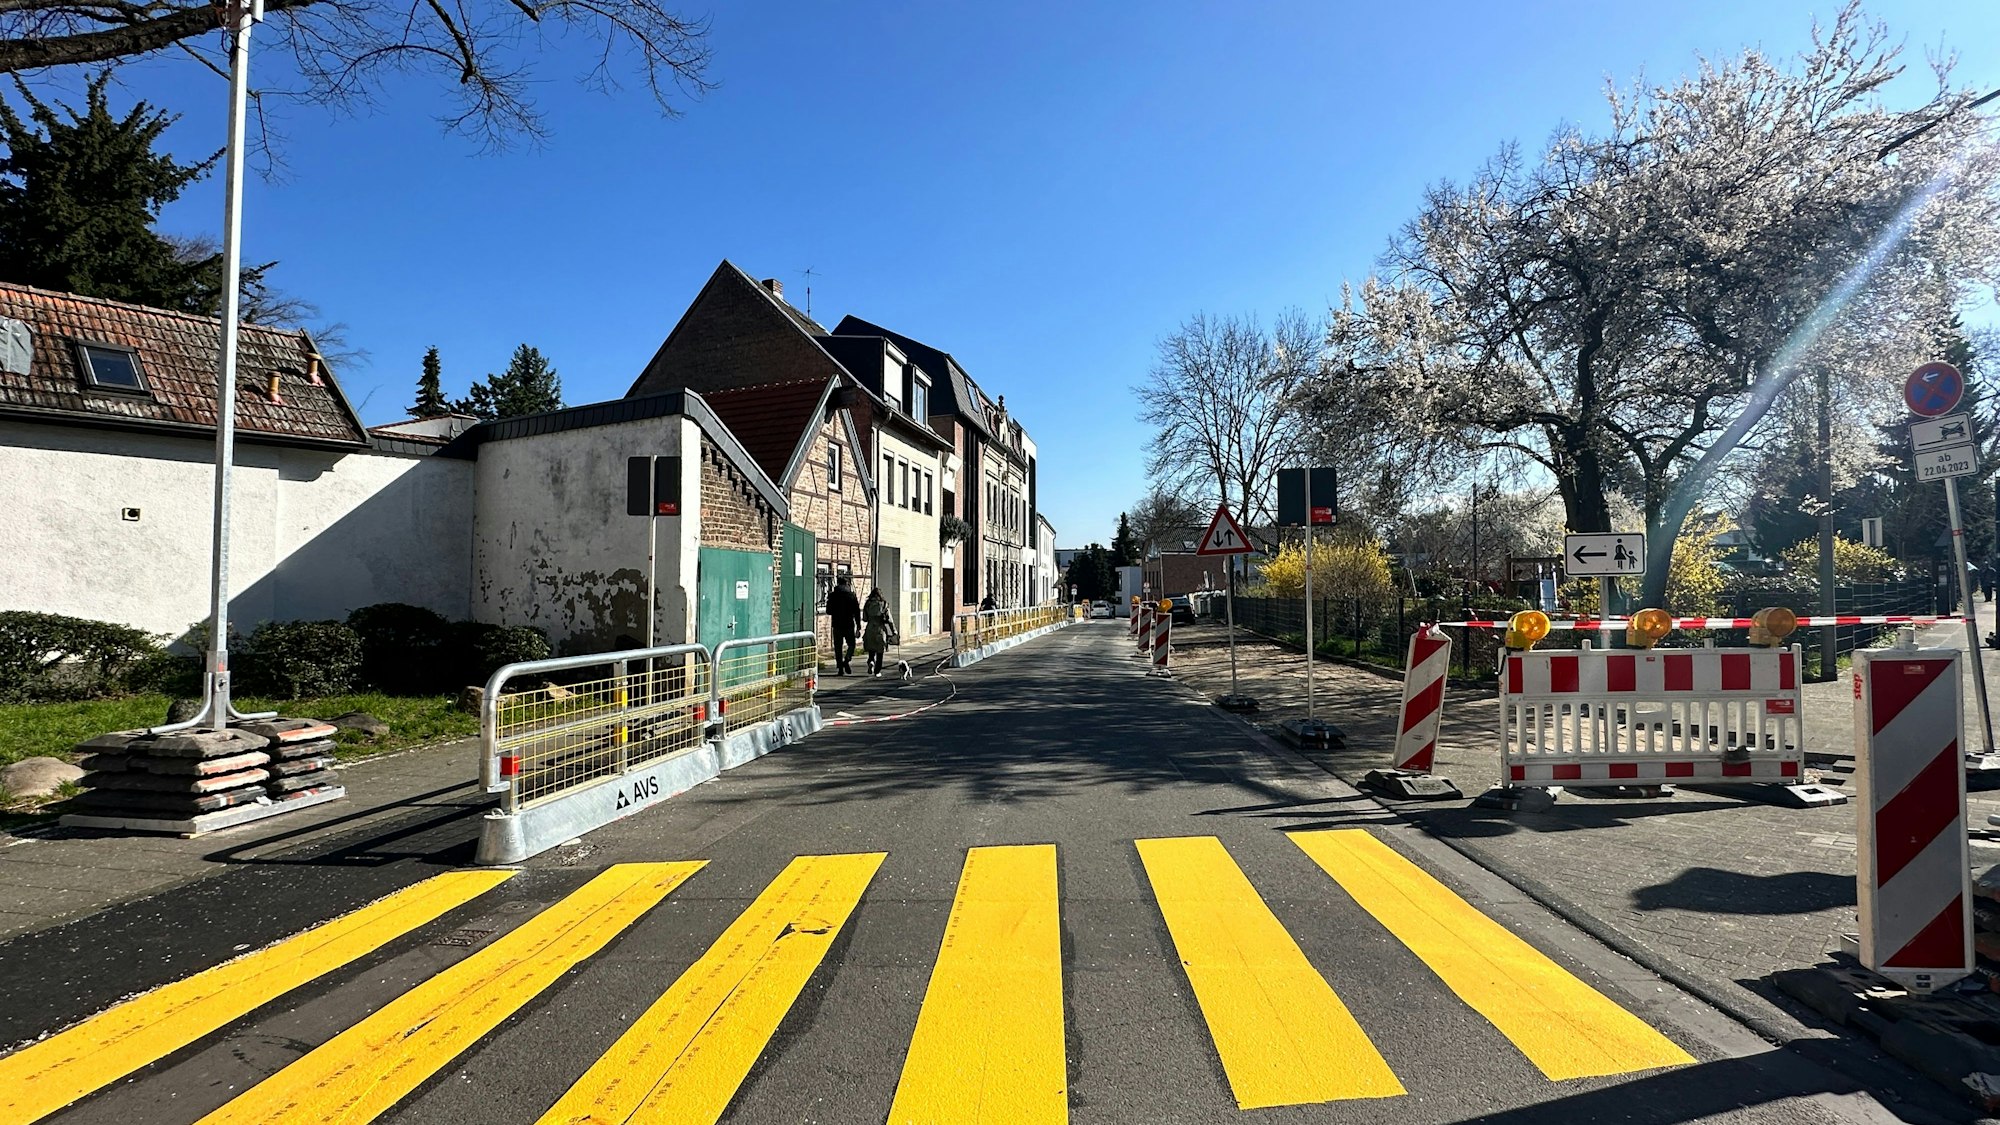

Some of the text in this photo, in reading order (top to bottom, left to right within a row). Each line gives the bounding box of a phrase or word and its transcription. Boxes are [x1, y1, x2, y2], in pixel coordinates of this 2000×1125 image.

[1938, 453, 1951, 462] ab
[1924, 461, 1969, 476] 22.06.2023
[634, 775, 659, 803] AVS
